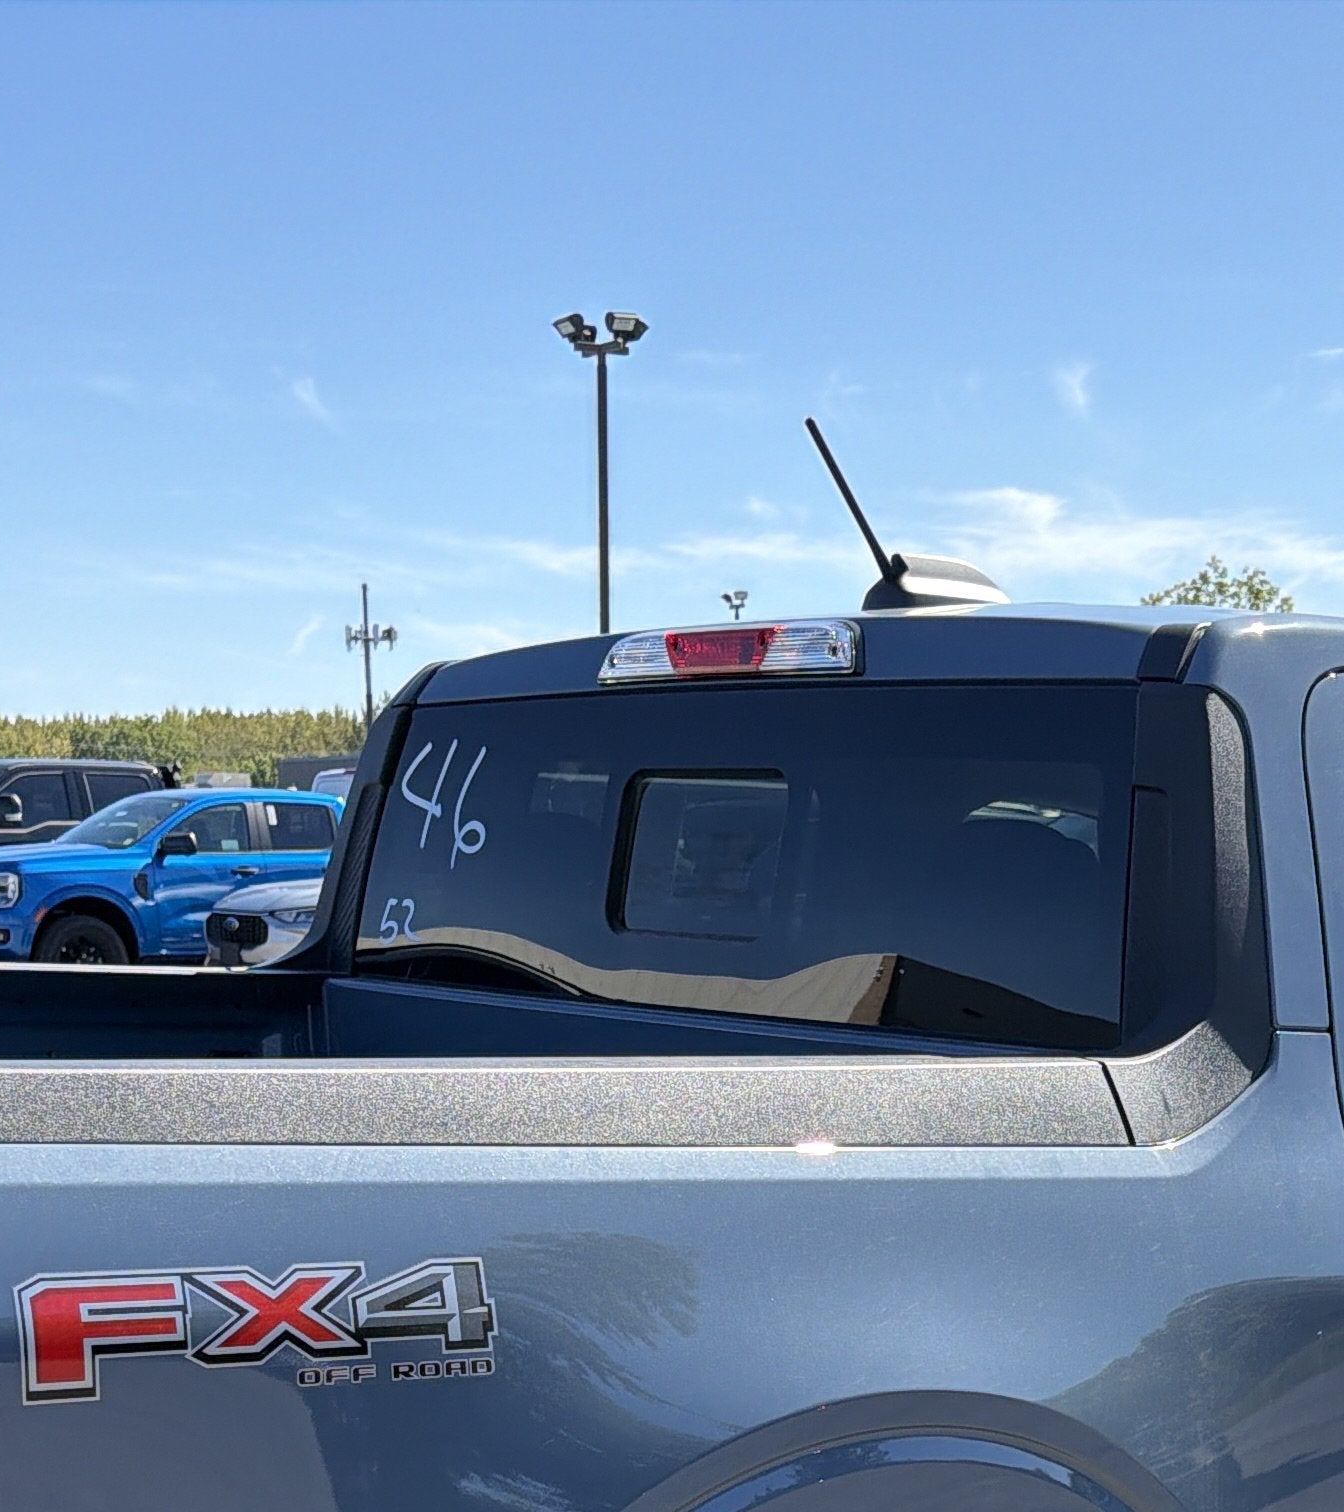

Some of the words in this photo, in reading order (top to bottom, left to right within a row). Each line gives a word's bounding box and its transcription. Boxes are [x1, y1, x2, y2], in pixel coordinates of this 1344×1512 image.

[401, 738, 487, 870] 46
[378, 898, 421, 944] 52
[13, 1257, 499, 1406] FX4
[297, 1363, 378, 1388] OFF
[392, 1357, 496, 1383] ROAD
